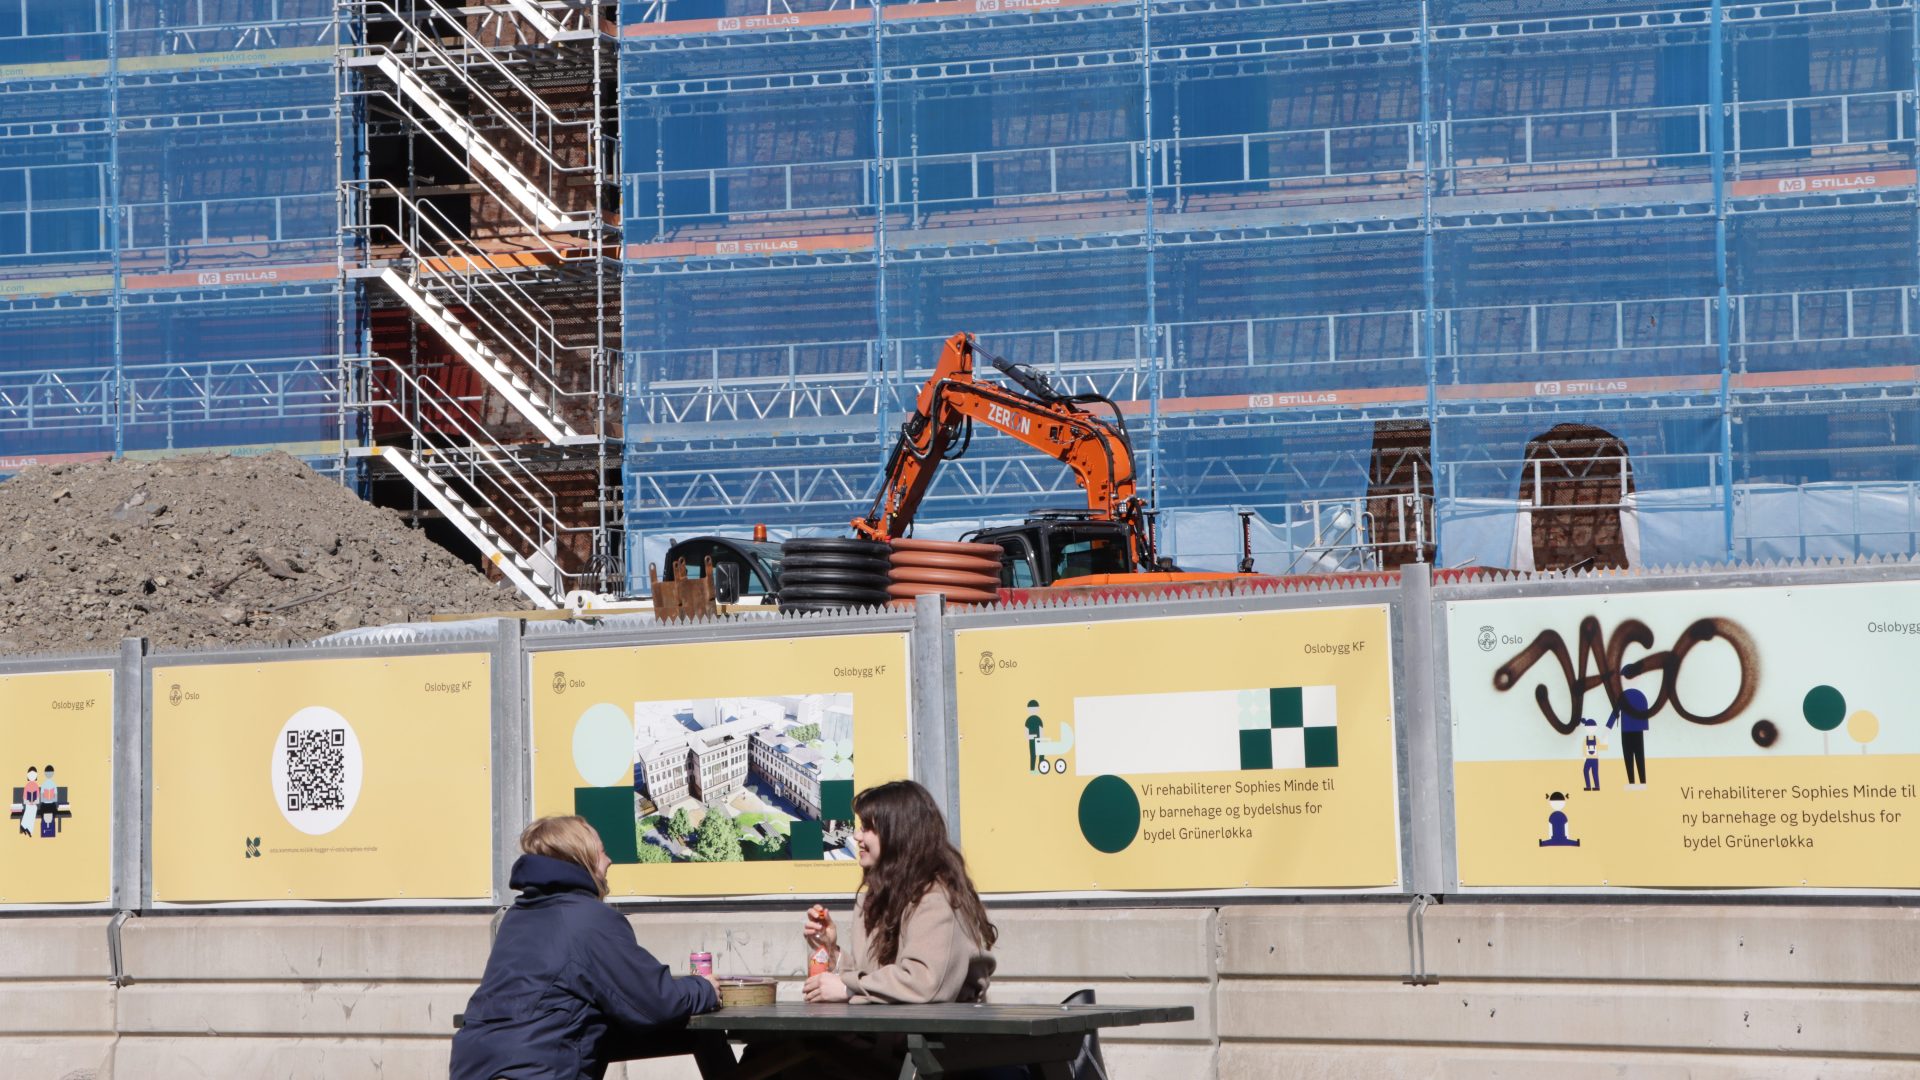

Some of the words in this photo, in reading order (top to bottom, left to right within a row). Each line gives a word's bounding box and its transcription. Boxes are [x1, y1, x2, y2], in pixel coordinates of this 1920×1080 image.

[746, 16, 800, 27] STILLAS
[1811, 176, 1876, 188] STILLAS
[744, 240, 798, 251] STILLAS
[225, 271, 277, 281] STILLAS
[1567, 381, 1628, 392] STILLAS
[1279, 393, 1337, 404] STILLAS
[0, 458, 37, 467] ILLAS
[1501, 634, 1523, 645] Oslo
[1304, 643, 1350, 656] Oslobygg
[1352, 641, 1365, 651] KF
[998, 659, 1017, 669] Oslo
[833, 666, 873, 679] Oslobygg
[875, 665, 886, 675] KF
[424, 682, 460, 693] Oslobygg
[462, 680, 472, 690] KF
[569, 679, 585, 688] Oslo
[184, 691, 200, 700] Oslo
[51, 700, 84, 711] Oslobygg
[86, 699, 95, 708] KF
[1141, 784, 1153, 796] Vi
[1156, 782, 1232, 796] rehabiliterer
[1235, 780, 1281, 796] Sophies
[1284, 779, 1319, 792] Minde
[1322, 778, 1335, 791] til
[1680, 786, 1694, 799] Vi
[1698, 785, 1787, 799] rehabiliterer
[1791, 785, 1849, 802] Sophies
[1853, 784, 1897, 798] Minde
[1901, 784, 1917, 798] til
[1142, 808, 1156, 821] ny
[1159, 805, 1222, 820] barnehage
[1225, 806, 1240, 819] og
[1243, 803, 1302, 818] bydelshus
[1305, 801, 1323, 814] for
[1682, 812, 1698, 827] ny
[1702, 810, 1776, 827] barnehage
[1780, 812, 1799, 827] og
[1802, 809, 1876, 827] bydelshus
[1879, 809, 1902, 823] for
[1143, 828, 1176, 843] bydel
[1179, 825, 1253, 841] Grünerløkka
[1683, 835, 1722, 851] bydel
[1725, 834, 1814, 848] Grünerløkka
